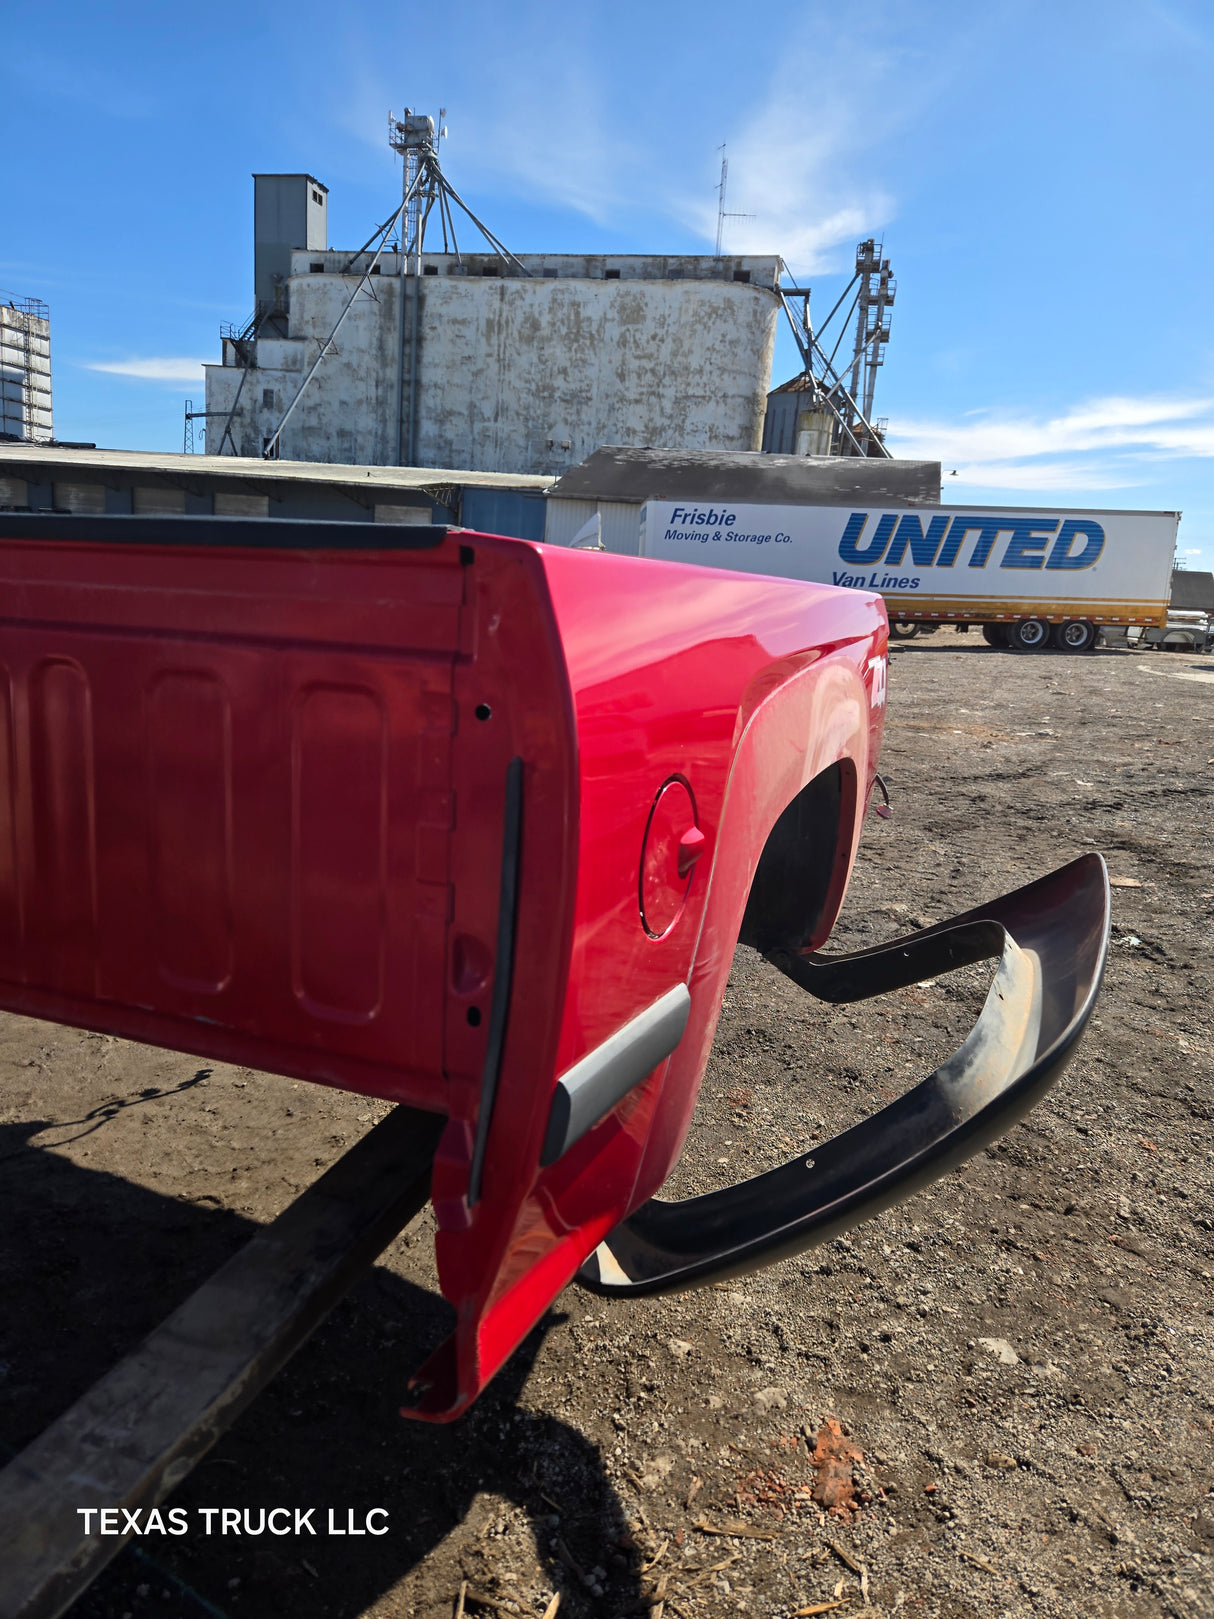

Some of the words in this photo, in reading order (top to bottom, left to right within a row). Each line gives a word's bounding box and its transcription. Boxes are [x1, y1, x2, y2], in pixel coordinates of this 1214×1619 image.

[670, 508, 736, 526] Frisbie
[664, 530, 709, 543] Moving
[712, 531, 722, 542] &
[725, 531, 771, 544] Storage
[774, 533, 793, 543] Co.
[838, 512, 1106, 571] UNITED
[832, 571, 866, 587] Van
[868, 572, 920, 588] Lines
